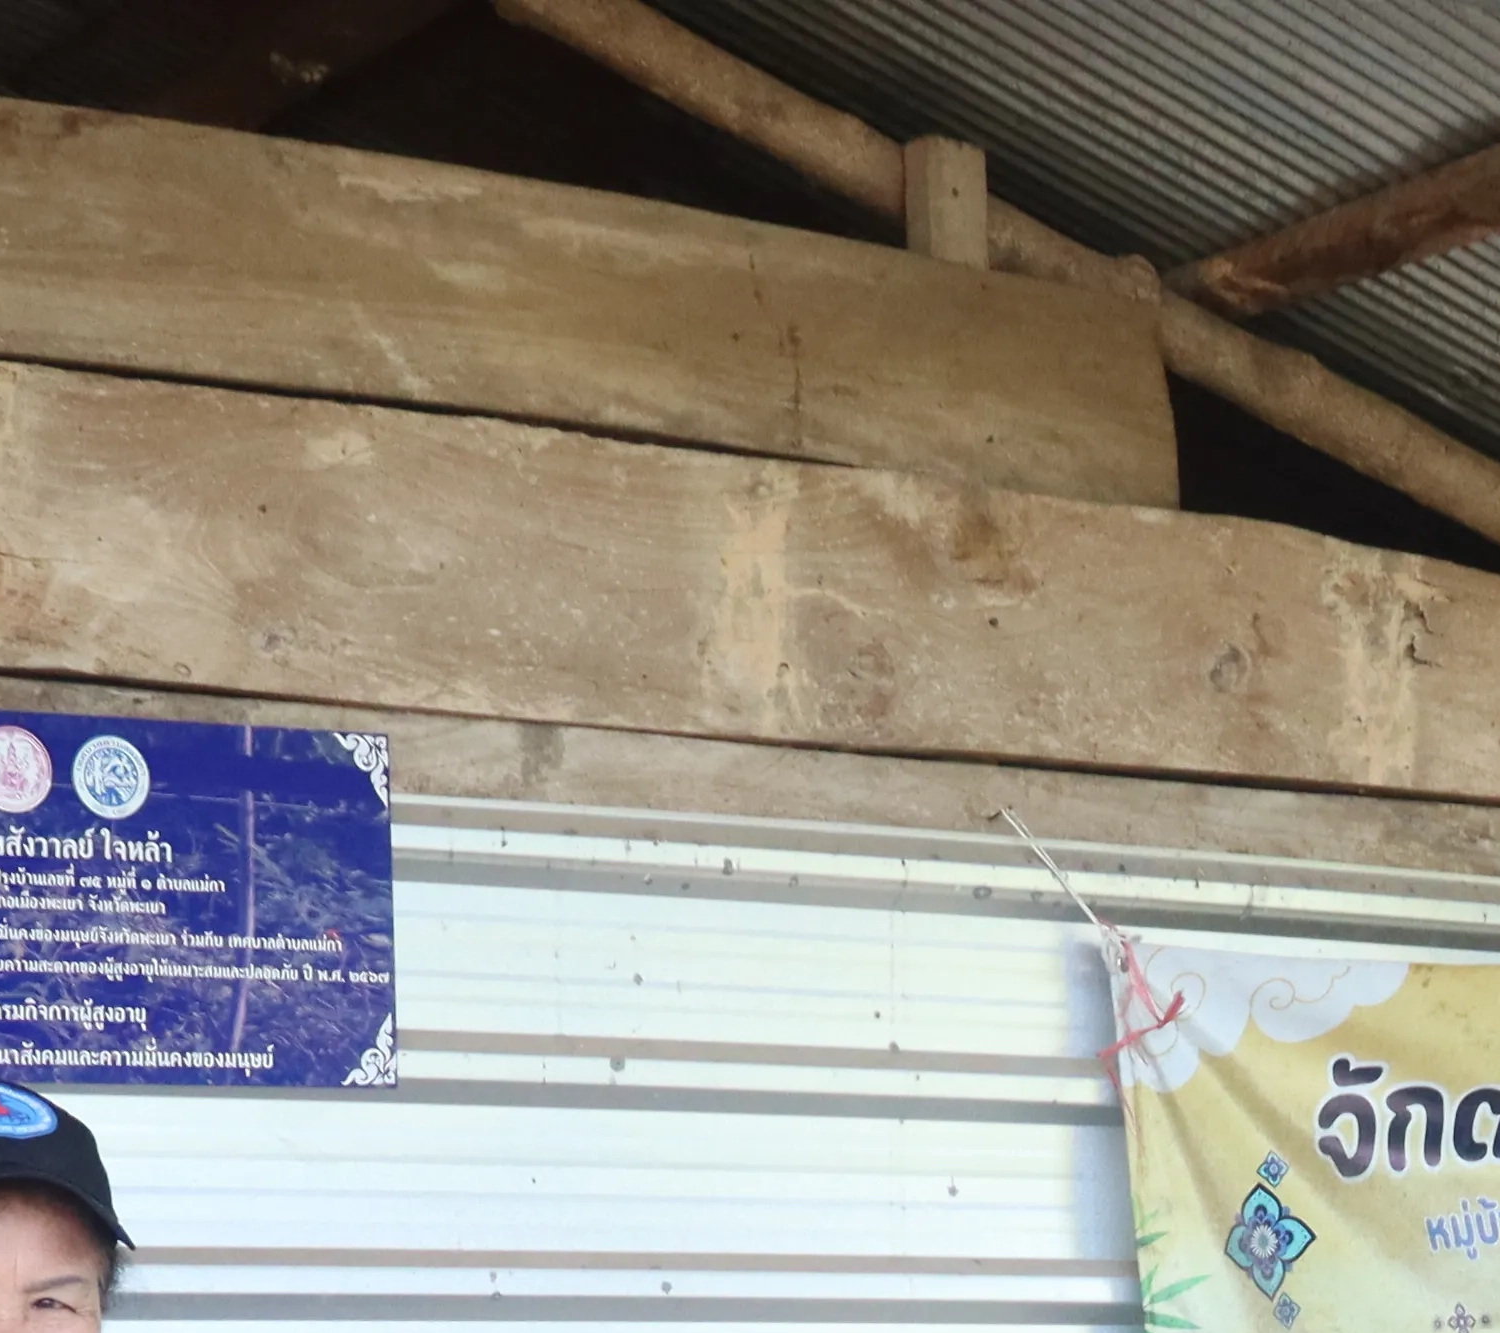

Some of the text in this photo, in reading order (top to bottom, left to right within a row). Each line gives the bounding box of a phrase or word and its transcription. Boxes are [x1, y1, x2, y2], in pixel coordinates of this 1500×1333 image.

[100, 828, 173, 863] ใจหล้า
[107, 868, 137, 895] หมู่ที่
[156, 873, 226, 893] ตำบลแม่กา
[88, 895, 166, 915] จังหวัดพะเยา
